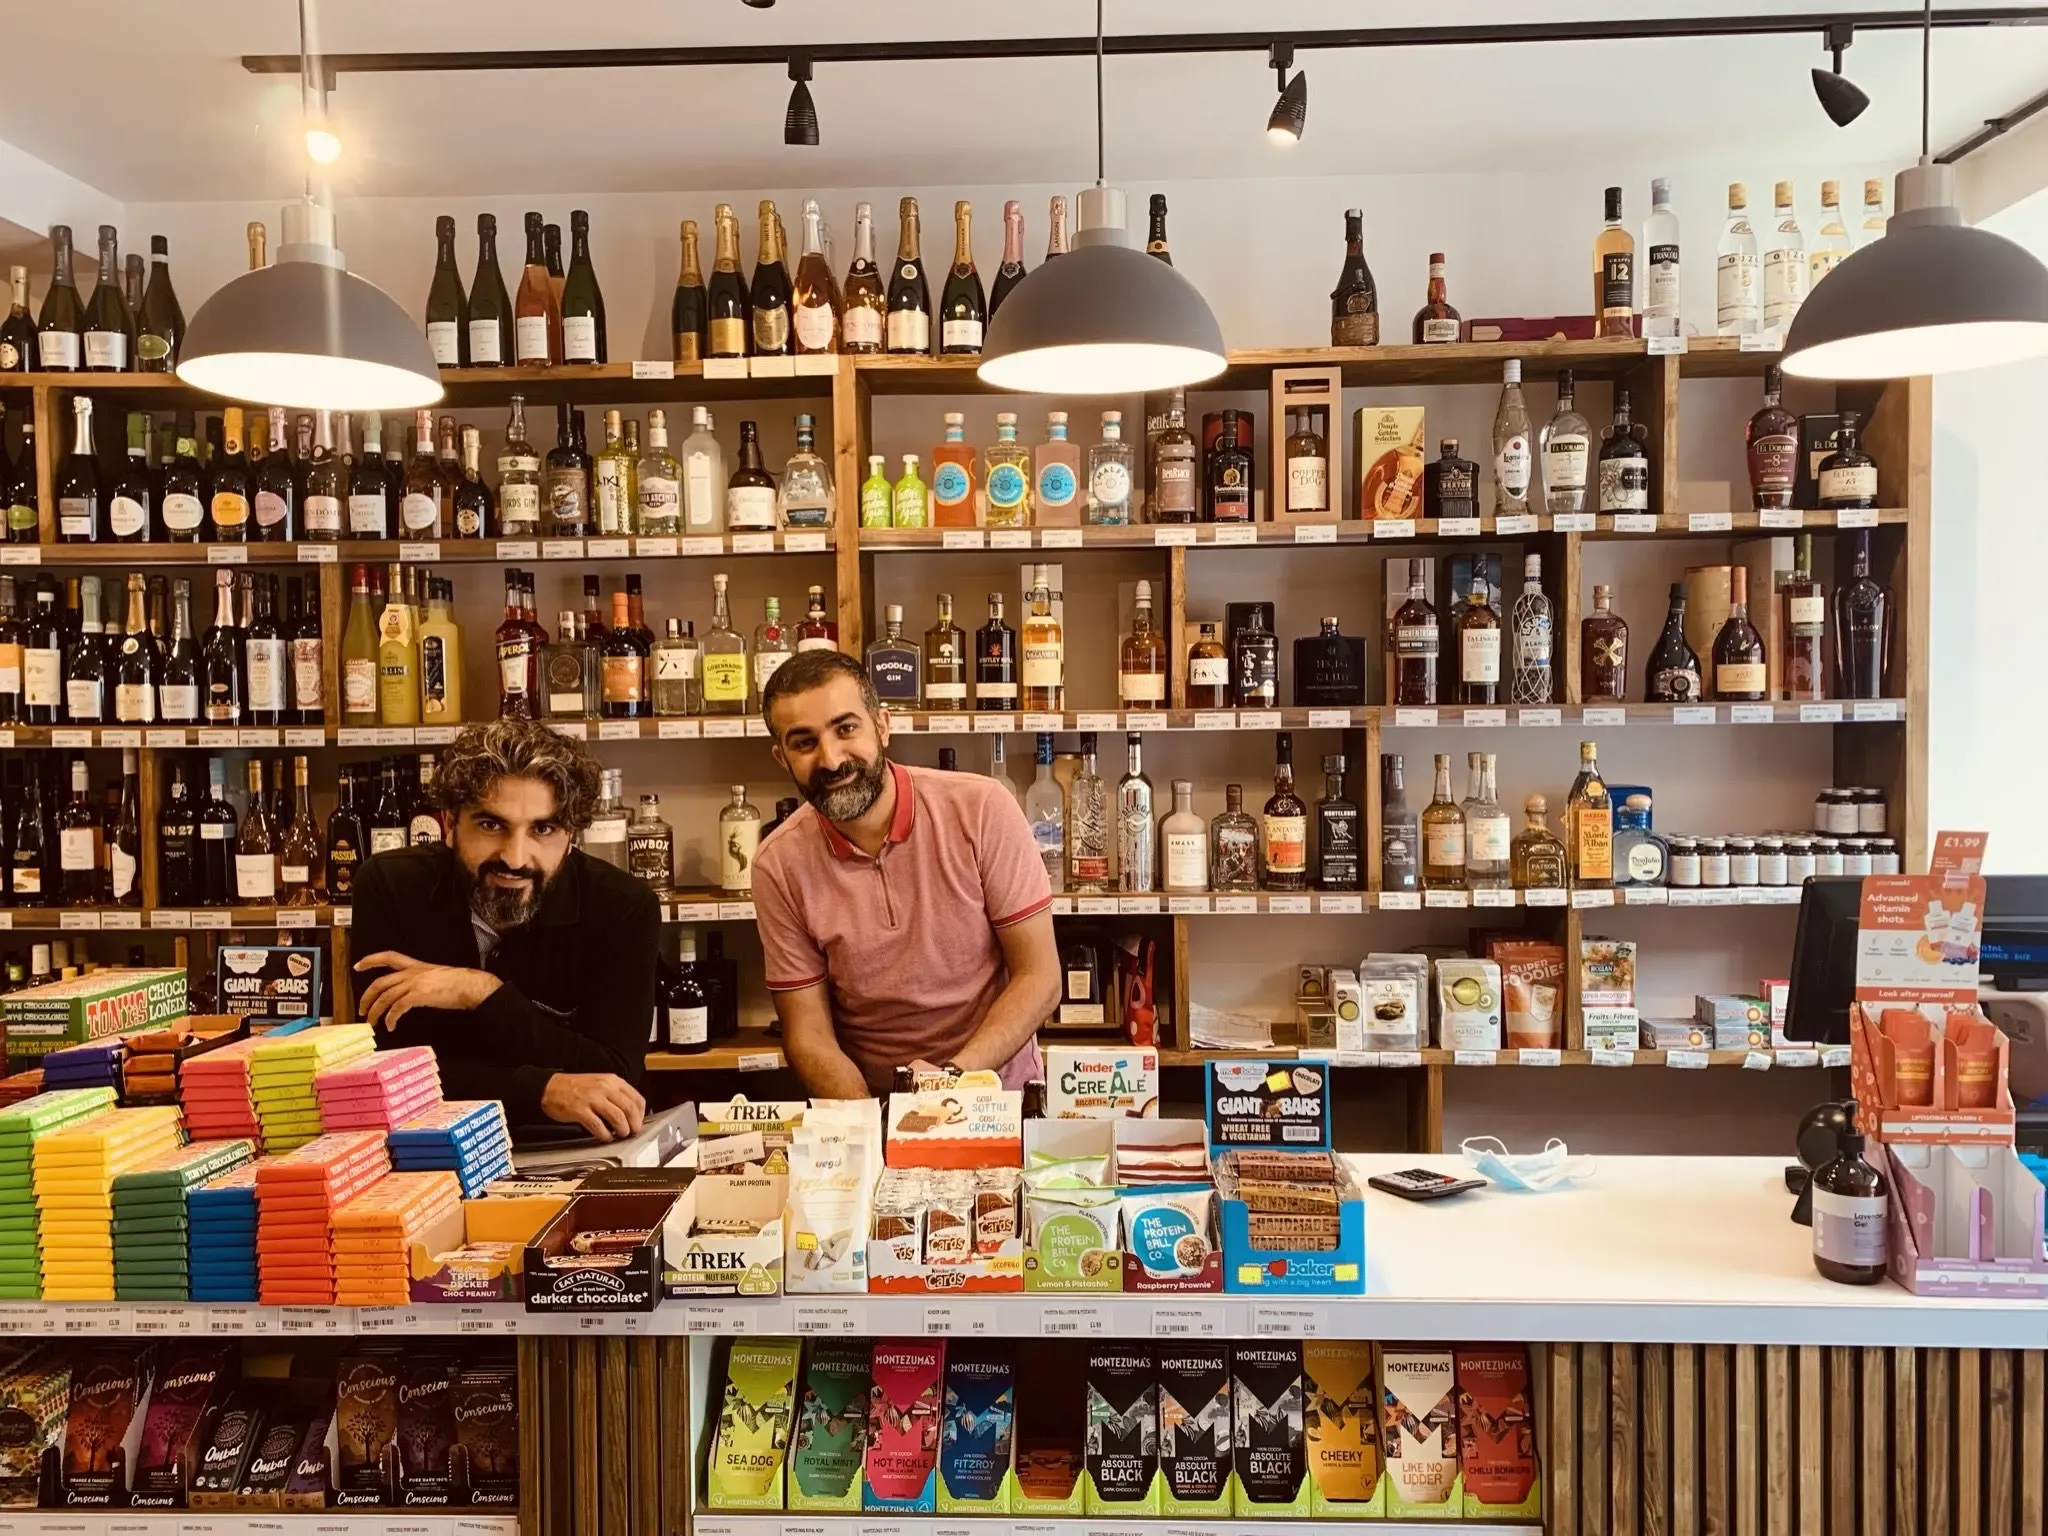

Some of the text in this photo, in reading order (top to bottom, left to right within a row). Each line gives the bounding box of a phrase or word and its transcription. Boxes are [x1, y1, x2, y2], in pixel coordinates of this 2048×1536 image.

[1611, 264, 1629, 281] 12
[1772, 455, 1780, 466] 8
[1292, 469, 1326, 480] COPPER
[1300, 476, 1321, 486] DOG
[876, 662, 914, 673] BOODLES
[178, 825, 194, 835] 27
[630, 839, 669, 851] JAWBOX
[1944, 837, 1980, 848] £1.99
[1867, 894, 1918, 902] Advanced
[1873, 904, 1910, 913] vitamin
[1877, 914, 1904, 924] shots
[1510, 959, 1549, 974] SUPER
[148, 978, 187, 1000] CHOCO
[224, 978, 309, 994] GIANT BARS
[1879, 990, 1955, 999] Look after yourself
[150, 996, 187, 1020] LONELY
[251, 1000, 267, 1008] FREE
[1074, 1060, 1114, 1073] Kinder
[1295, 1071, 1321, 1086] CHOCOLATE
[1108, 1096, 1118, 1108] 7
[1217, 1096, 1320, 1116] GIANT BARS
[730, 1104, 780, 1120] TREK
[720, 1123, 785, 1132] PROTEIN NUT BARS
[969, 1123, 1015, 1133] CREMOSO
[1221, 1124, 1270, 1133] WHEAT FREE
[1229, 1133, 1271, 1141] VEGETARIAN
[514, 1181, 554, 1193] Halva
[1079, 1210, 1096, 1221] PLANT
[1141, 1217, 1162, 1228] THE
[1256, 1217, 1330, 1232] HANDMADE
[1050, 1225, 1070, 1236] THE
[1144, 1224, 1187, 1239] PROTEIN
[929, 1238, 965, 1251] Cards
[1051, 1235, 1095, 1247] PROTEIN
[1147, 1238, 1172, 1250] BALL
[1251, 1237, 1325, 1251] HANDMADE
[1052, 1247, 1078, 1257] BALL
[687, 1252, 746, 1269] TREK
[1286, 1259, 1334, 1276] baker
[450, 1273, 489, 1281] TRIPLE
[558, 1272, 620, 1288] EAT NATURAL
[672, 1273, 705, 1281] PROTEIN
[705, 1273, 719, 1281] NUT
[926, 1273, 965, 1288] Cards
[1296, 1278, 1309, 1287] big
[1037, 1280, 1063, 1288] Lemon
[1137, 1282, 1211, 1291] Raspberry Brownie
[531, 1293, 573, 1304] darker
[732, 1354, 792, 1365] MONTEZUMA'S
[876, 1355, 935, 1365] MONTEZUMA'S
[1237, 1351, 1297, 1361] MONTEZUMA'S
[812, 1362, 870, 1373] MONTEZUMA'S
[1090, 1357, 1152, 1368] MONTEZUMA'S
[1161, 1359, 1223, 1370] MONTEZUMA'S
[1387, 1362, 1450, 1373] MONTEZUMA'S
[1460, 1360, 1523, 1371] MONTEZUMA'S
[951, 1363, 1010, 1374] MONTEZUMA'S
[74, 1378, 133, 1401] Conscious
[338, 1375, 397, 1398] Conscious
[455, 1402, 514, 1421] Conscious
[205, 1442, 243, 1461] Ombar
[1250, 1453, 1291, 1461] ABSOLUTE
[1321, 1450, 1363, 1461] CHEEKY
[251, 1455, 291, 1473] Ombar
[727, 1454, 774, 1466] SEA DOG
[804, 1457, 854, 1467] ROYAL MINT
[874, 1458, 929, 1468] HOT PICKLE
[953, 1459, 995, 1469] FITZROY
[1101, 1460, 1143, 1468] ABSOLUTE
[1175, 1462, 1217, 1470] ABSOLUTE
[1250, 1462, 1291, 1474] BLACK
[1402, 1463, 1442, 1472] LIKE NO
[1469, 1466, 1493, 1474] CHILLI
[1101, 1469, 1143, 1481] BLACK
[1175, 1471, 1217, 1483] BLACK
[1403, 1474, 1442, 1485] UDDER
[67, 1492, 110, 1504] Conscious
[131, 1494, 174, 1506] Conscious
[337, 1492, 380, 1505] Conscious
[406, 1492, 448, 1505] Conscious
[472, 1490, 514, 1503] Conscious
